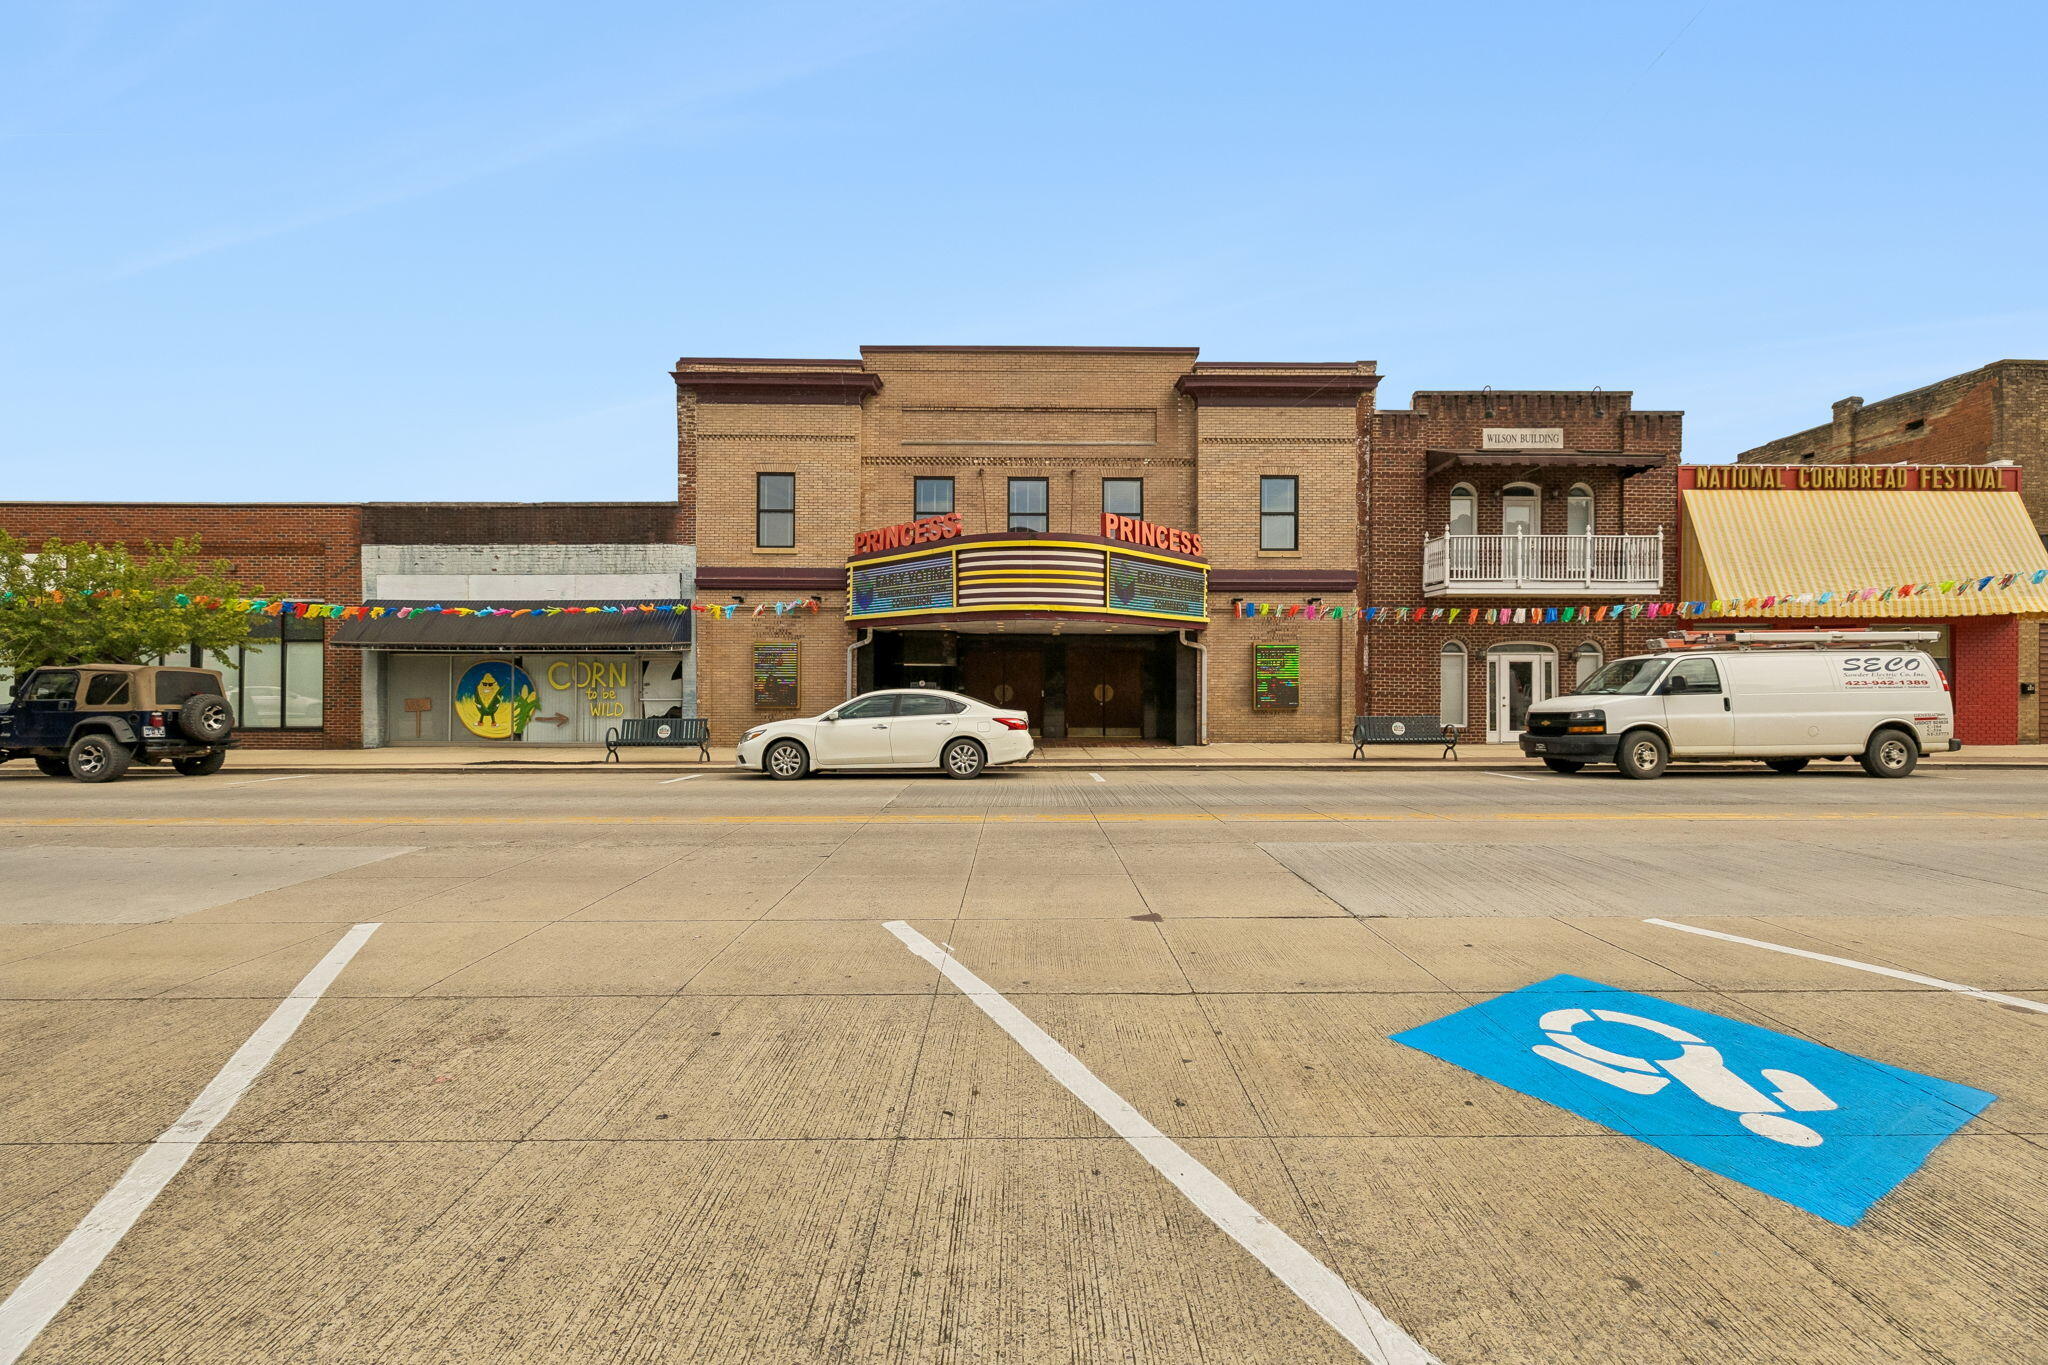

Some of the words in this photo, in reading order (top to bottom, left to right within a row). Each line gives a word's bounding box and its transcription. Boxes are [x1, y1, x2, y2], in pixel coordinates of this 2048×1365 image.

[1486, 433, 1518, 444] WILSON
[1520, 433, 1560, 444] BUILDING
[1695, 466, 1786, 489] NATIONAL
[1797, 466, 1907, 489] CORNBREAD
[1919, 466, 2007, 489] FESTIVAL
[854, 512, 960, 555] PRINCESS
[1102, 512, 1203, 556] PRINCESS
[876, 571, 905, 588] EARLY
[907, 565, 951, 584] VOTING
[1137, 570, 1167, 587] EARLY
[1169, 576, 1203, 592] VOTING
[1842, 656, 1921, 672] SECO
[548, 661, 627, 690] CORN
[585, 687, 598, 700] to
[602, 687, 617, 700] be
[589, 701, 625, 717] WILD
